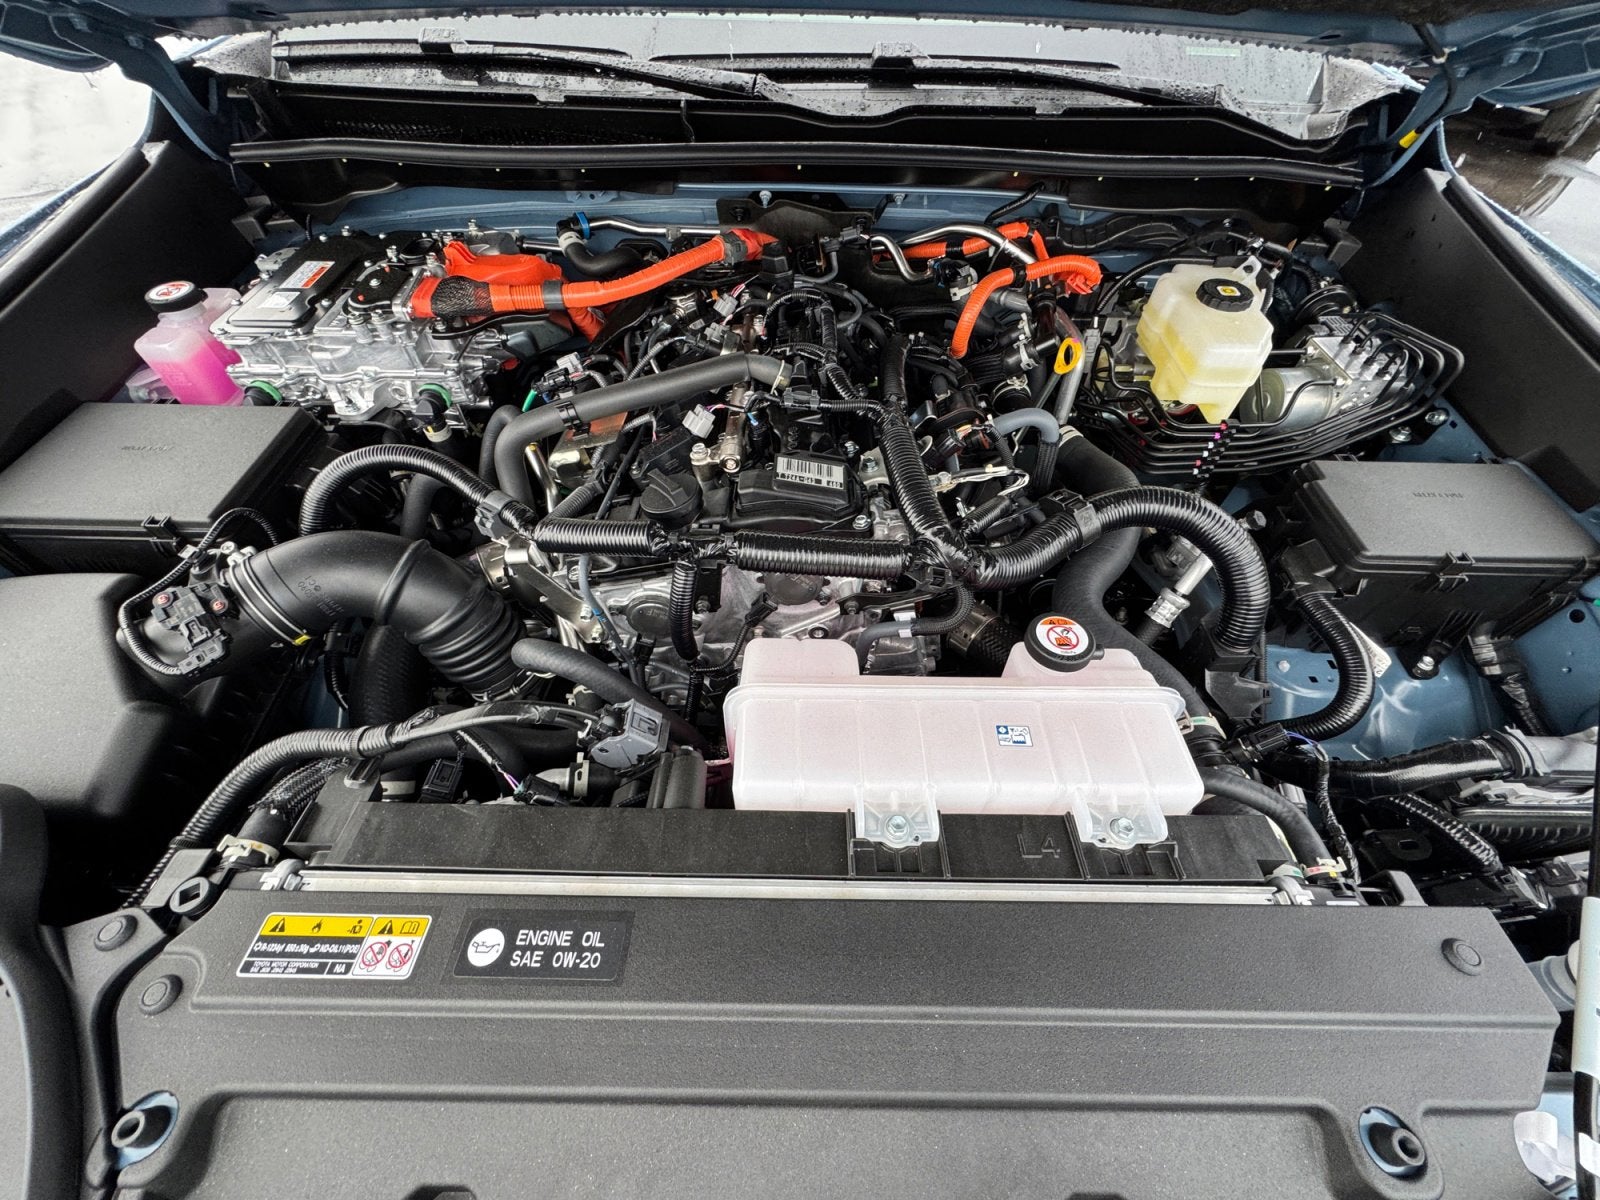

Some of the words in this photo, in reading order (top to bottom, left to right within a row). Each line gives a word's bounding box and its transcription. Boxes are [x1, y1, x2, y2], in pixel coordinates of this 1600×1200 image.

[516, 929, 573, 946] ENGINE
[581, 931, 605, 947] OIL
[288, 961, 320, 969] CORPORATION
[510, 950, 544, 967] SAE
[552, 951, 601, 968] 0W-20
[333, 963, 346, 973] NA
